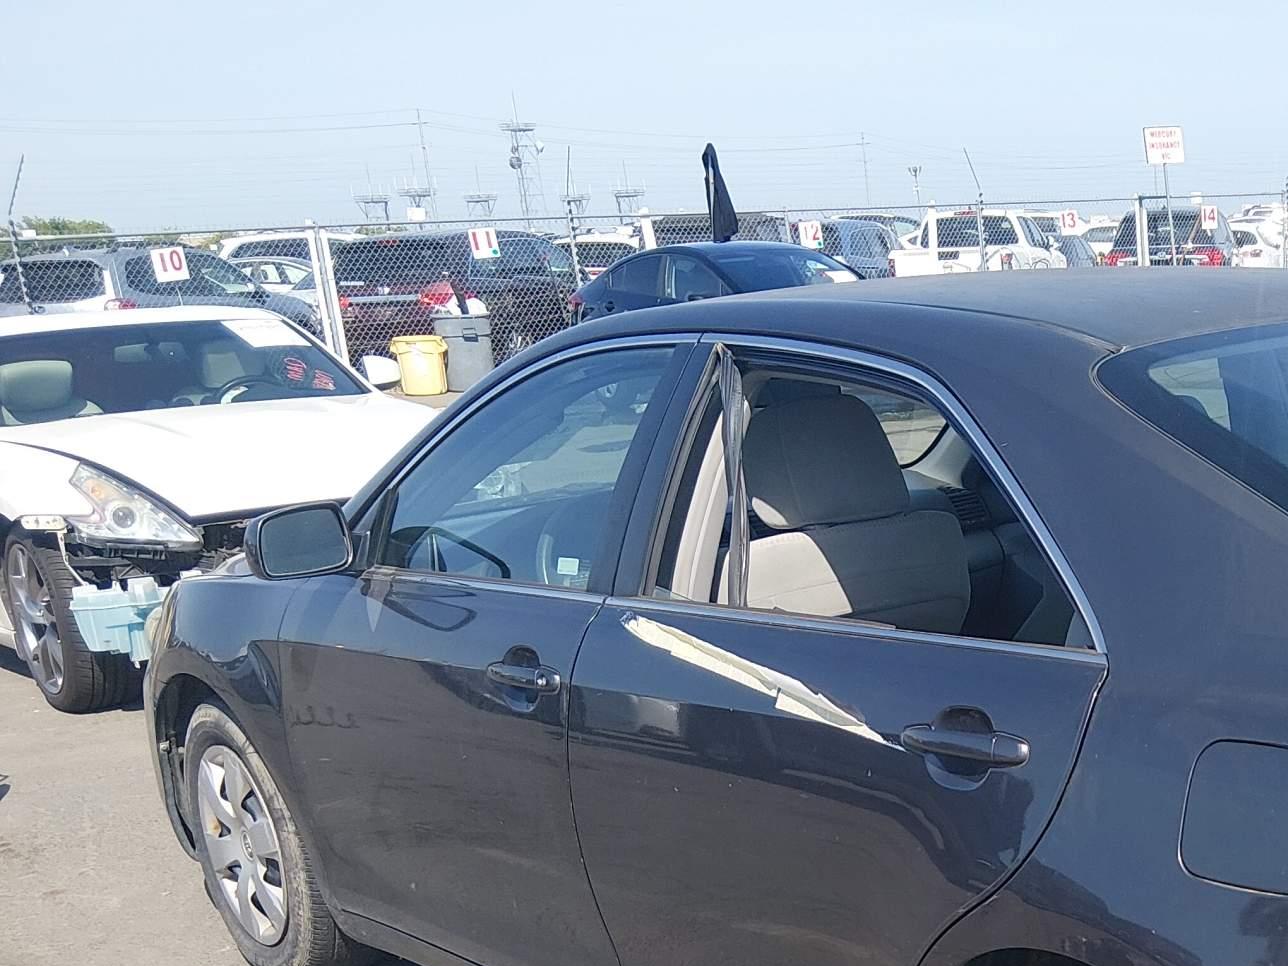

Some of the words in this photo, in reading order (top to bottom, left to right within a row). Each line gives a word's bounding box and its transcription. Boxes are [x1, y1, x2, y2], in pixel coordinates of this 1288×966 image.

[1062, 212, 1076, 228] 13
[1203, 208, 1216, 223] 14
[471, 231, 493, 250] 11
[804, 223, 820, 241] 12
[159, 250, 183, 272] 10
